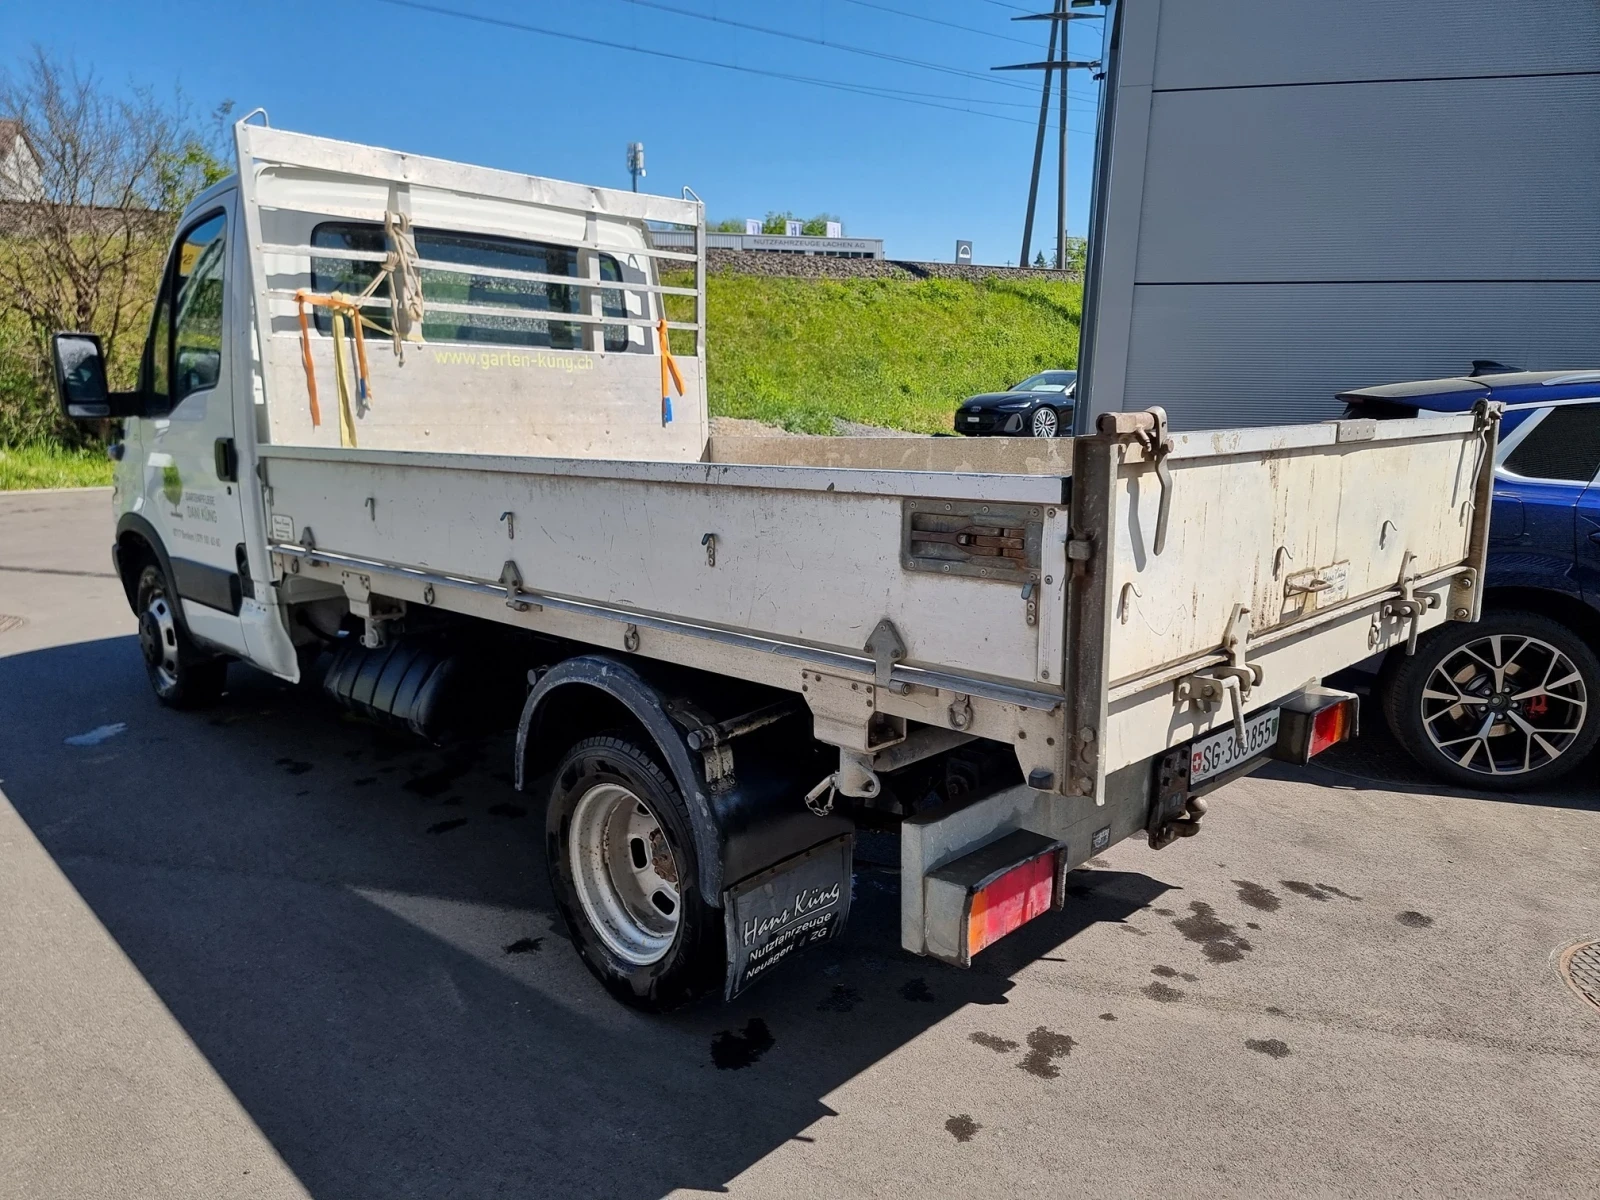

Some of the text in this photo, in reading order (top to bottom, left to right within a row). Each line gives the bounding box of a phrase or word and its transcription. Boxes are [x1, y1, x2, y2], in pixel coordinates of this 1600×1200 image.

[753, 238, 821, 248] NUTZFAHRZEUGE
[822, 241, 853, 249] LACHEN
[743, 882, 840, 946] Hans Küng
[749, 912, 832, 962] Nutzfahrzeuge
[809, 927, 827, 941] ZG
